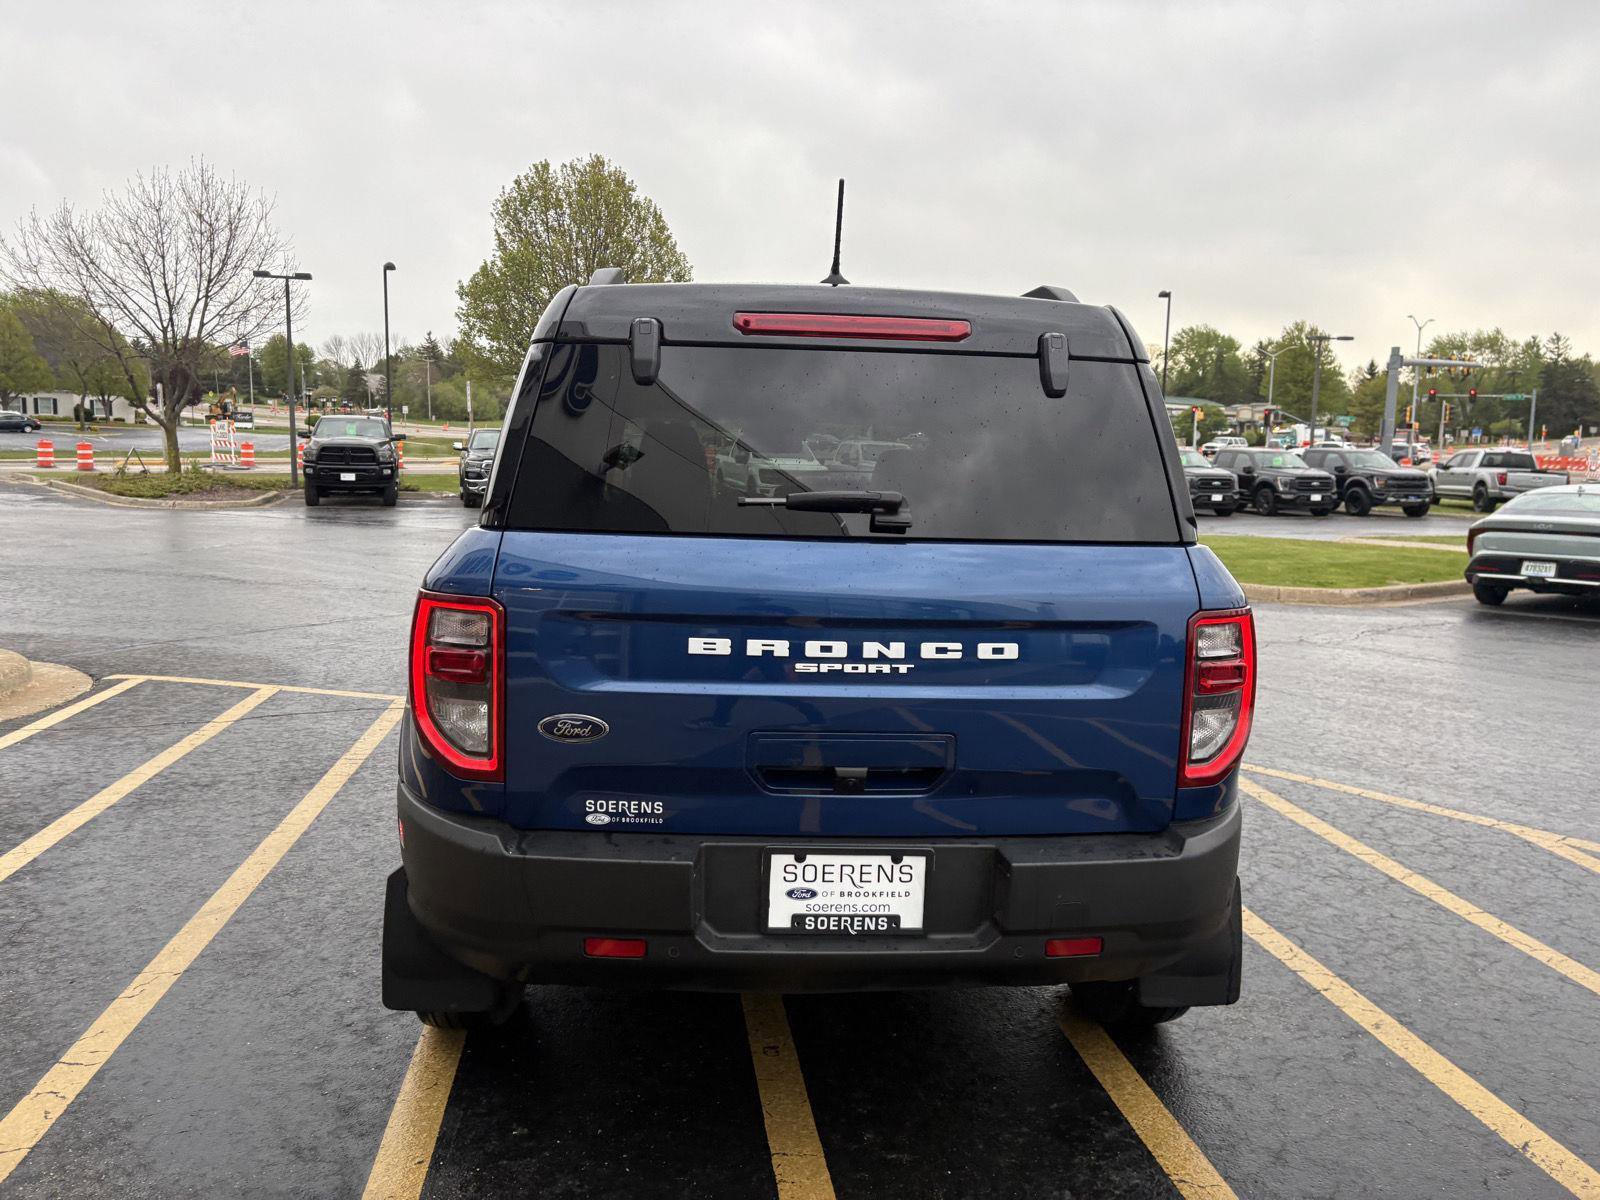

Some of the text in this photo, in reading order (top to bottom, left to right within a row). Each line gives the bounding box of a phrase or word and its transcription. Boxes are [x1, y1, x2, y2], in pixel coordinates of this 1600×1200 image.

[688, 637, 1019, 659] BRONCO
[795, 663, 915, 673] SPORT
[585, 800, 663, 817] SOERENS
[783, 864, 913, 889] SOERENS
[805, 903, 891, 913] soerens.com
[805, 917, 888, 935] SOERENS
